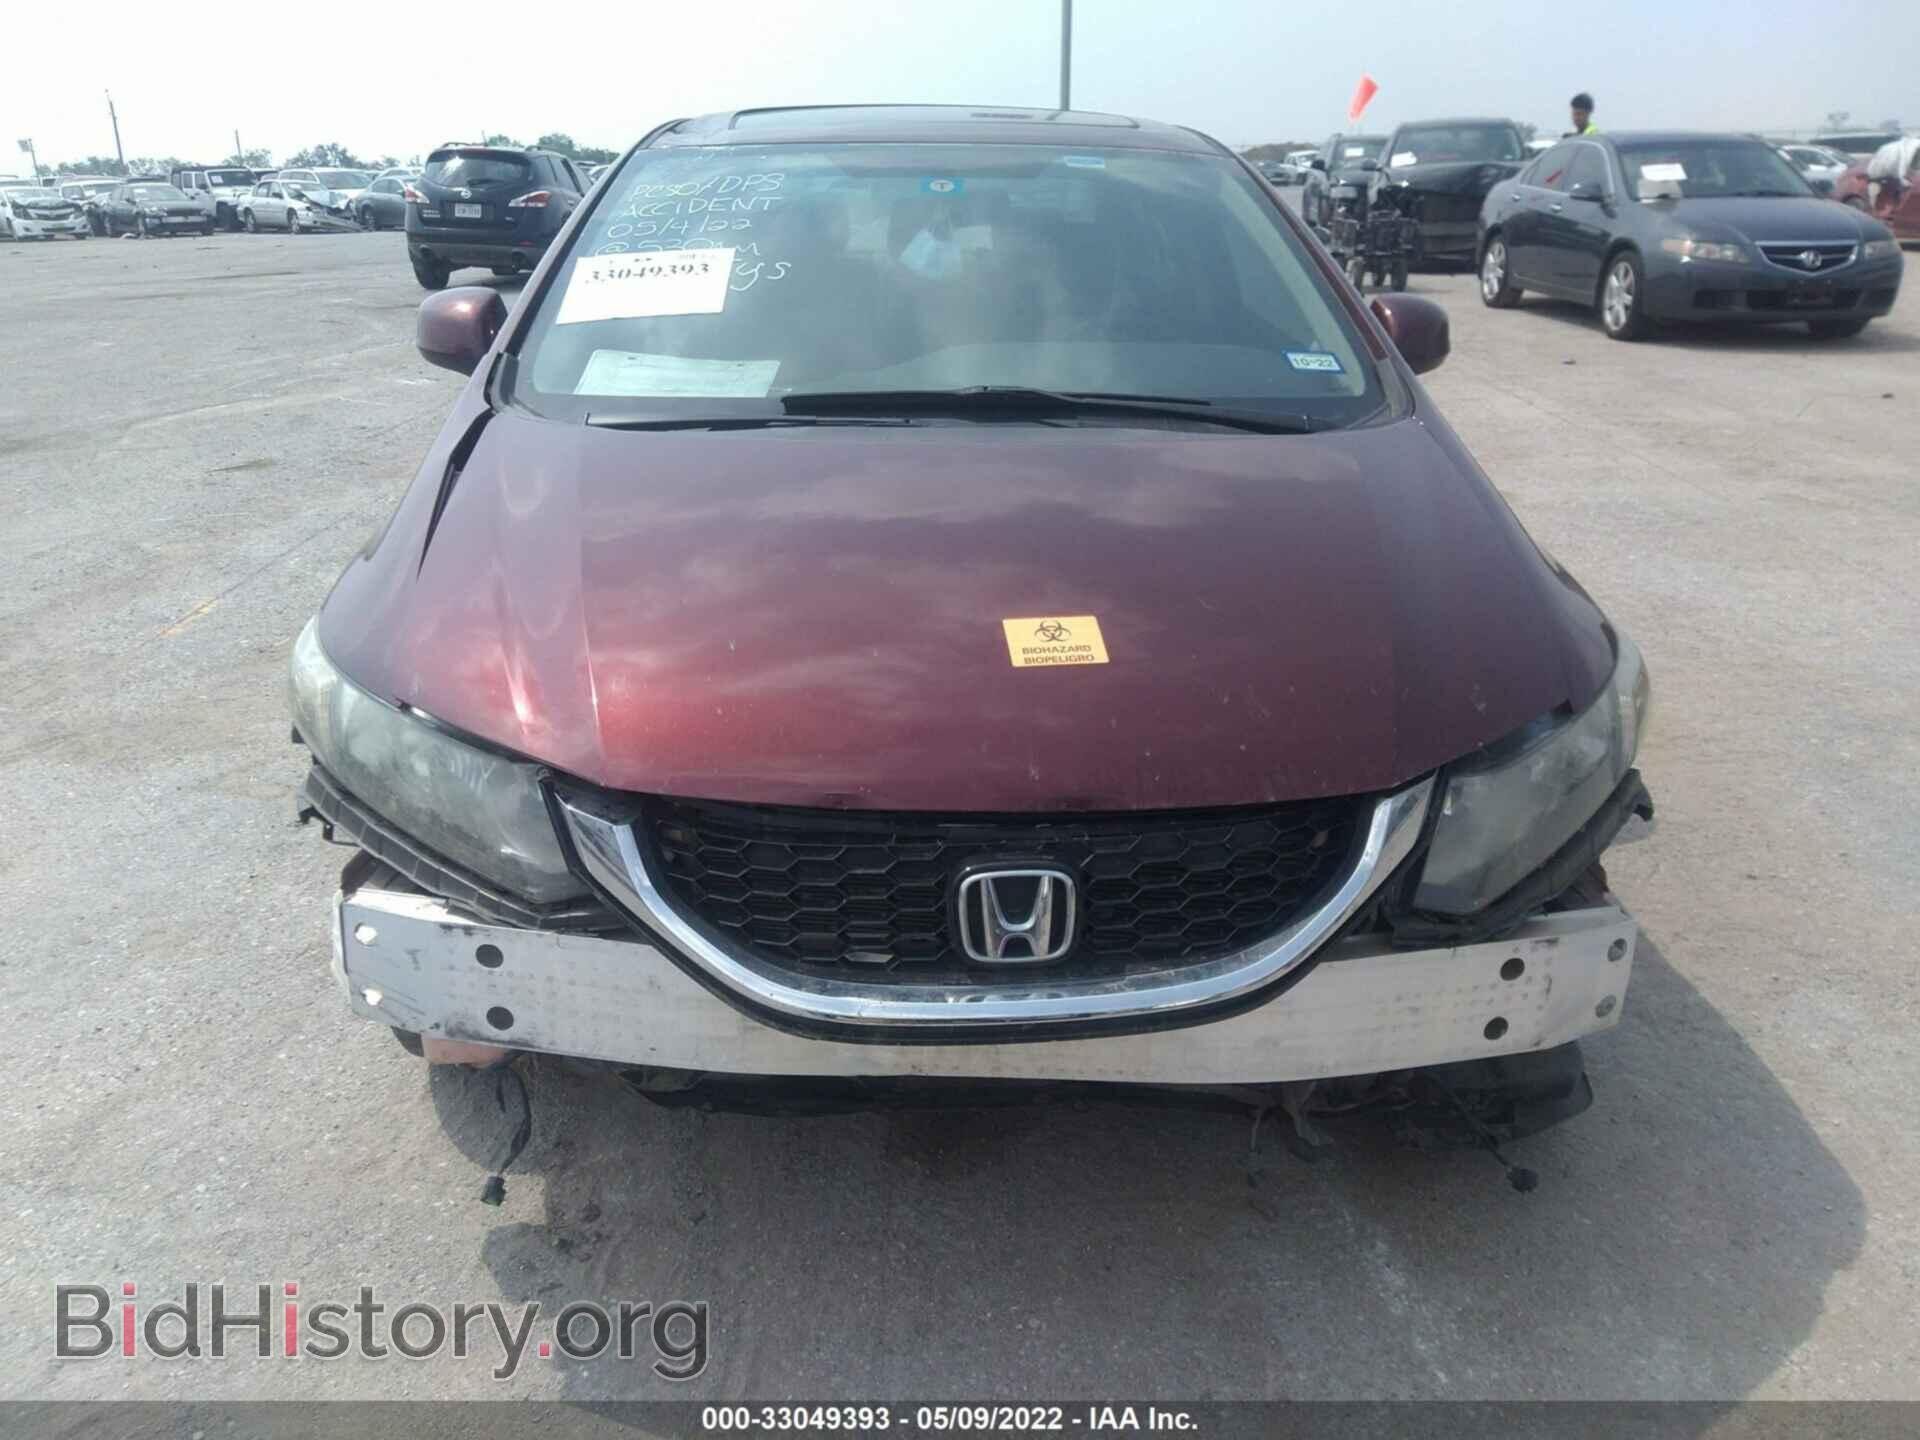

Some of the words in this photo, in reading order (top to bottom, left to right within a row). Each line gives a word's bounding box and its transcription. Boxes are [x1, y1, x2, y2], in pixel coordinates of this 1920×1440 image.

[622, 195, 785, 218] ACCIDENT
[1021, 644, 1092, 655] BIOHAZARD
[1023, 653, 1095, 665] BIOPELIGRO
